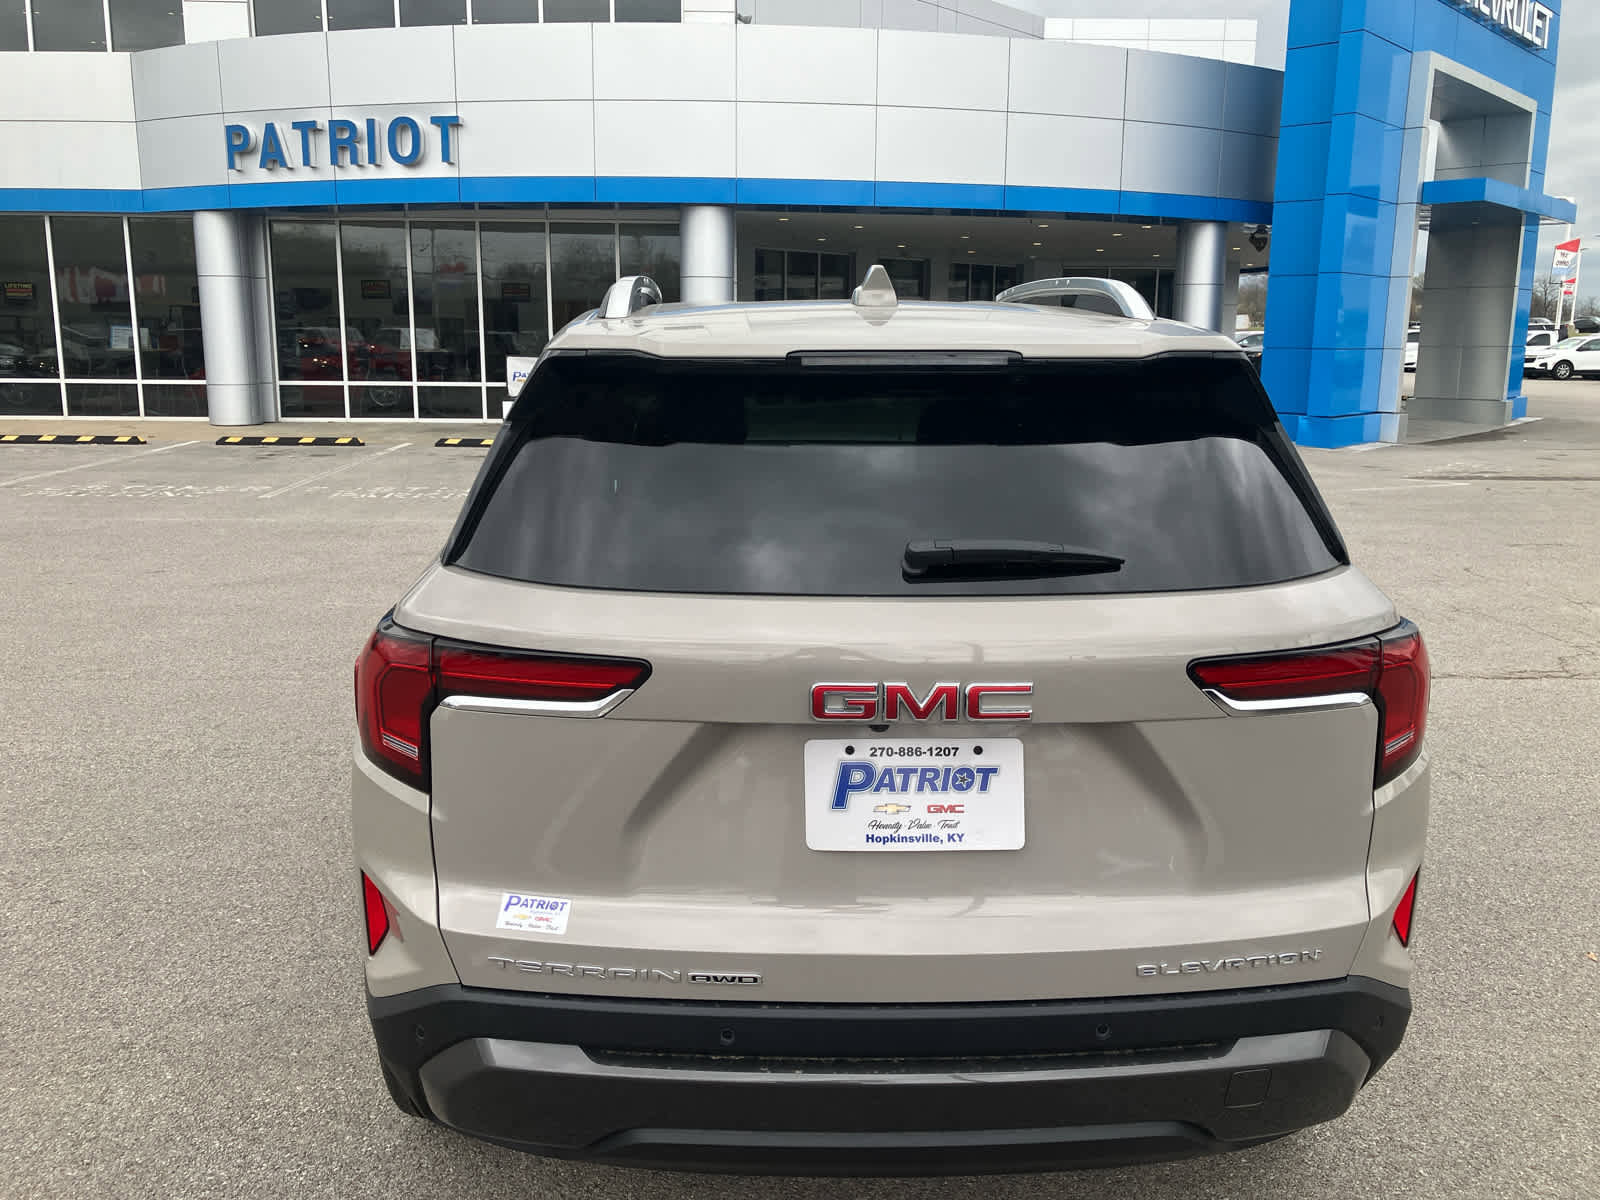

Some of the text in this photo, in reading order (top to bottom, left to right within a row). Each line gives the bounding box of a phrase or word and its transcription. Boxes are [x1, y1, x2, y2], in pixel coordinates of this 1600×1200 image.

[225, 115, 462, 171] PATRIOT
[811, 681, 1034, 722] GMC
[869, 746, 960, 757] 270-886-1207
[831, 761, 1000, 811] PATRIOT
[927, 804, 965, 814] GMC
[865, 833, 965, 845] Hopkinsville, KY
[503, 895, 569, 912] PATRIOT
[487, 956, 762, 985] TERRAIN AWD
[1136, 949, 1323, 977] ELEVATION
